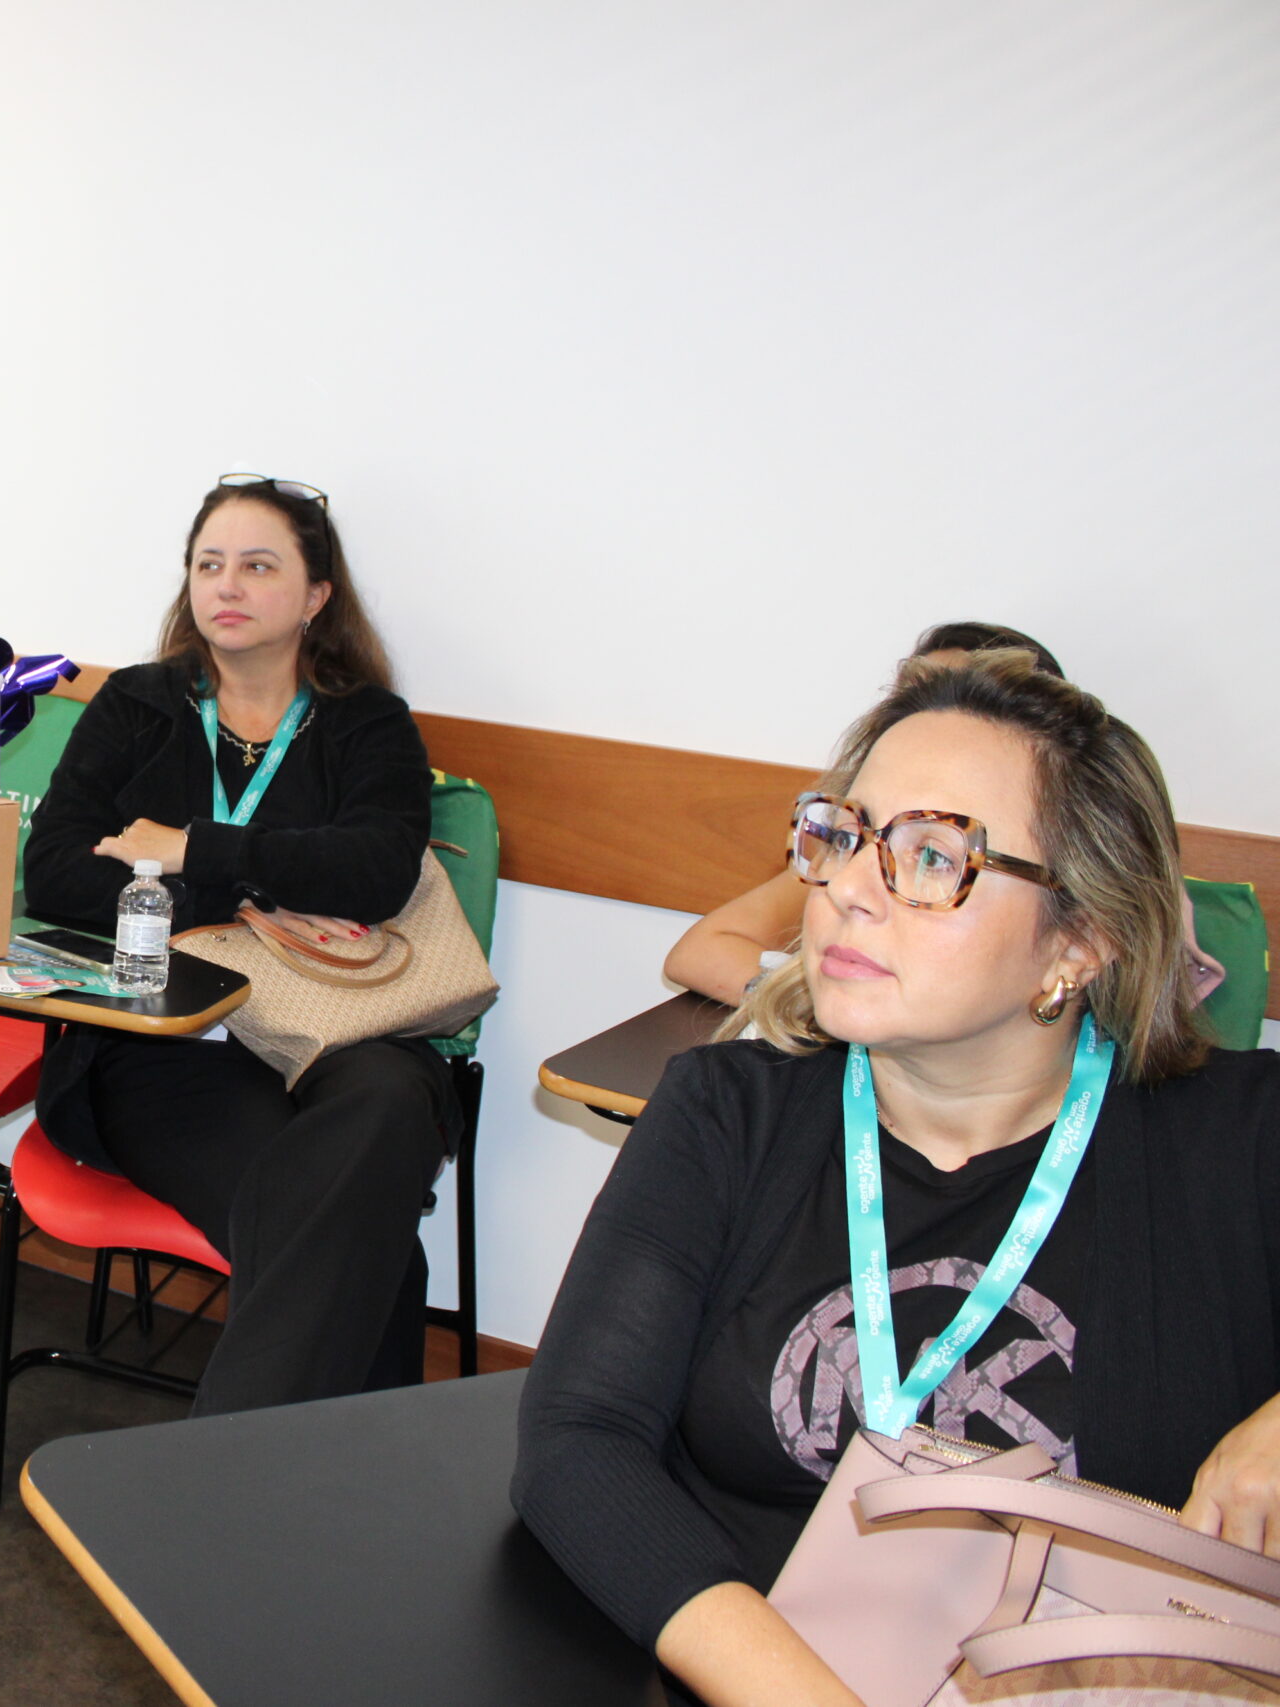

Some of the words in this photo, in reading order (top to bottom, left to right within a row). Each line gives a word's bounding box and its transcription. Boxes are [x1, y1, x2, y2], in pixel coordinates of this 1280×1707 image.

[1073, 1090, 1092, 1129] agente
[862, 1132, 874, 1160] gente
[1048, 1138, 1068, 1168] gente
[858, 1175, 871, 1214] agente
[866, 1294, 880, 1336] agente
[951, 1315, 982, 1347] agente
